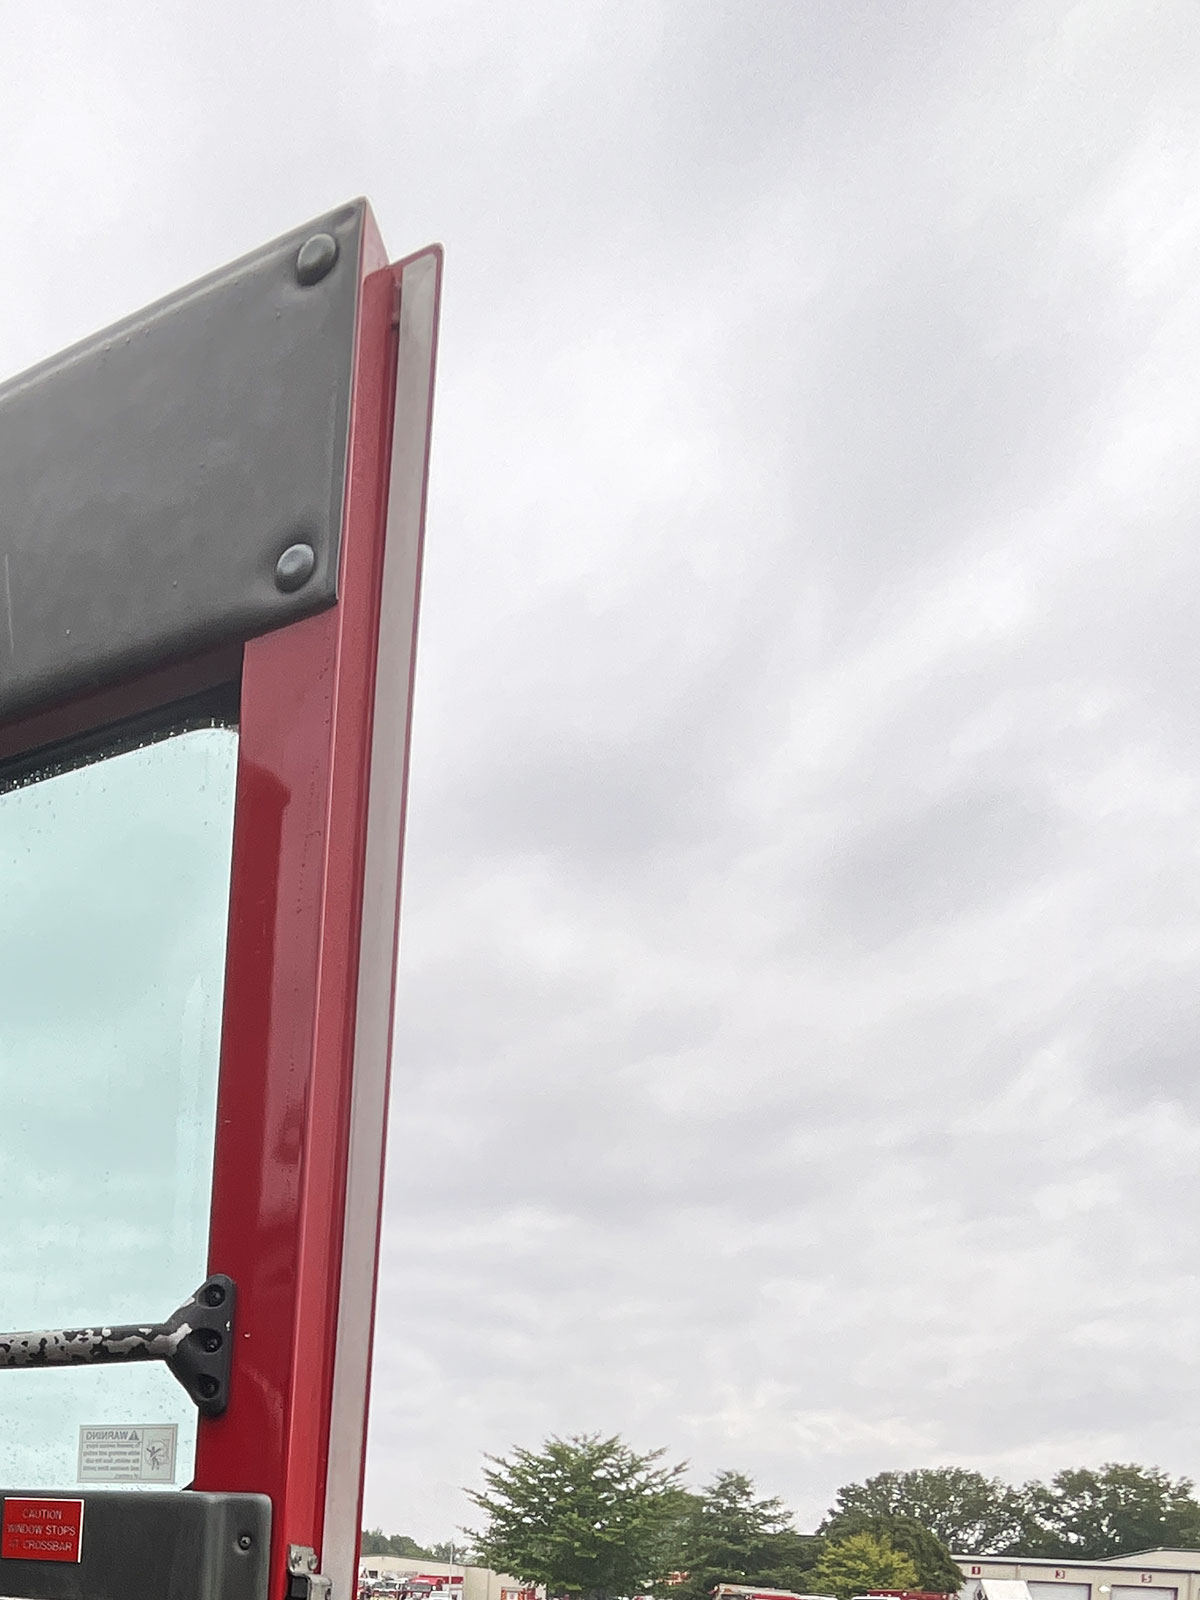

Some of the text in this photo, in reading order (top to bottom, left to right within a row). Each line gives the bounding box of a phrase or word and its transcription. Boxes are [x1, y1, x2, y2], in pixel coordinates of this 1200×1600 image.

[22, 1508, 62, 1520] CAUTION
[7, 1523, 76, 1536] WINDOW STOPS
[23, 1540, 73, 1551] CROSSBAR
